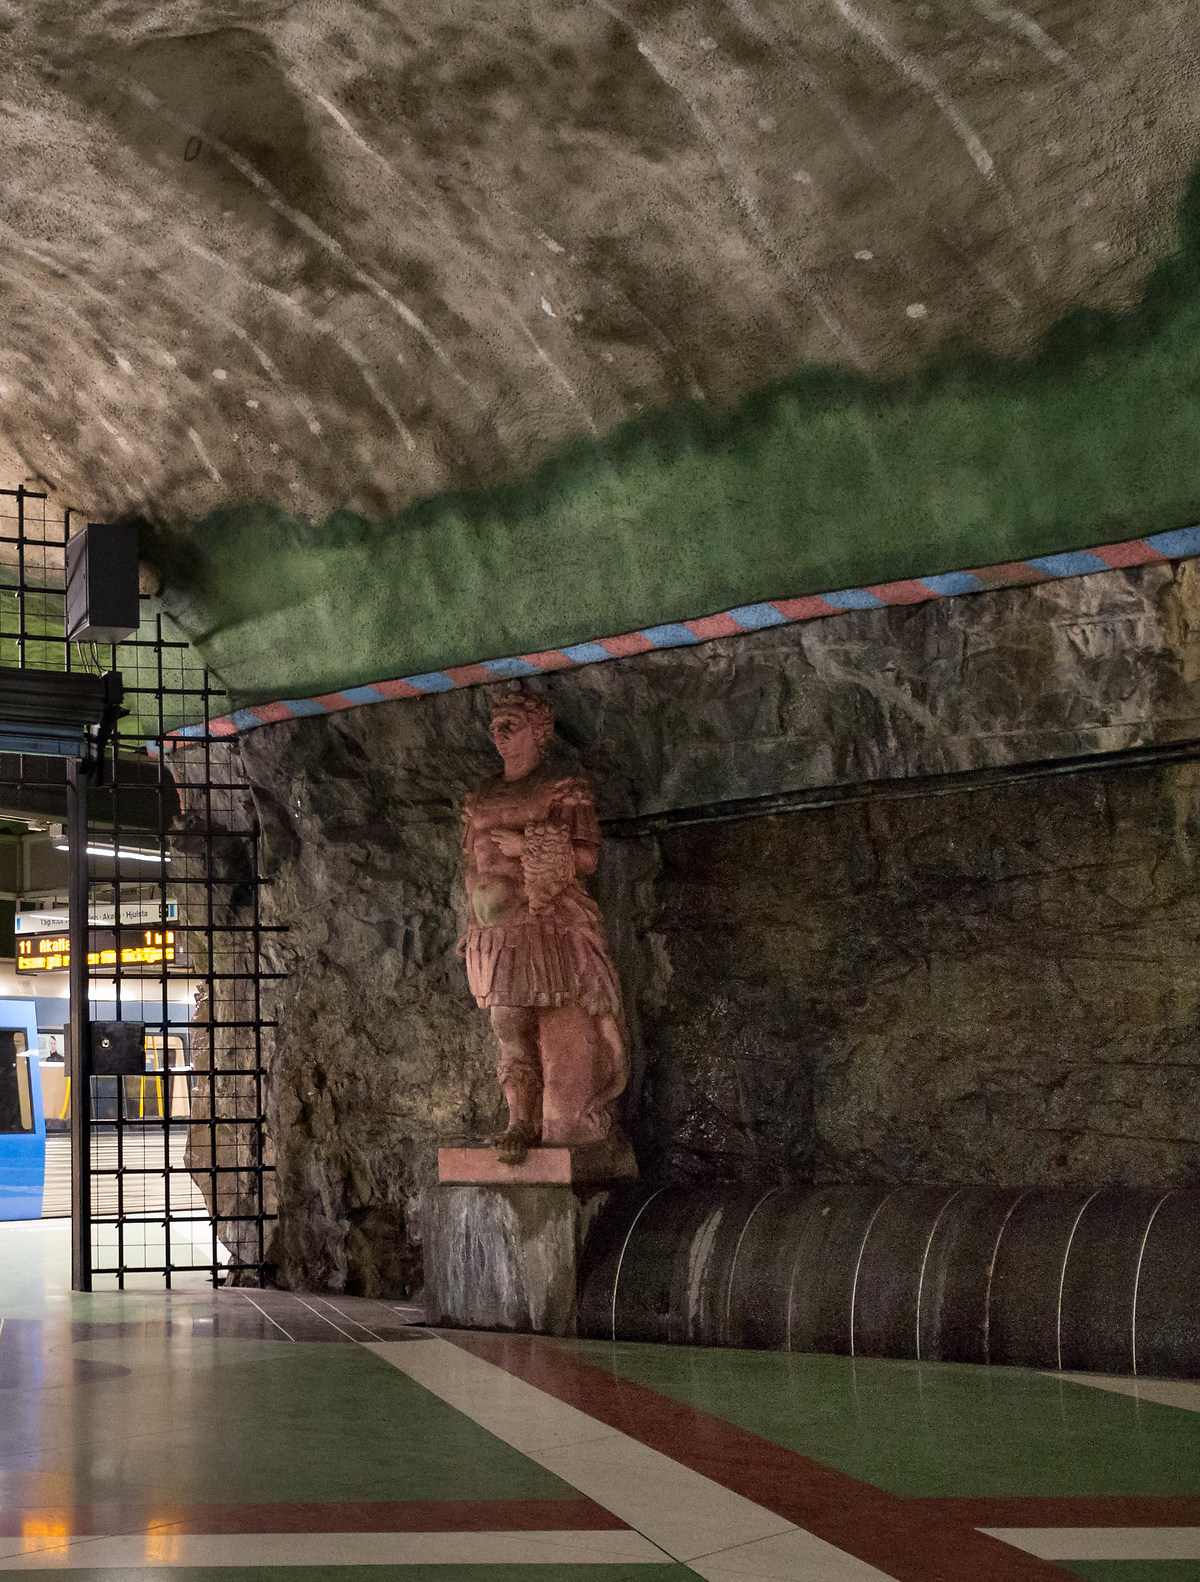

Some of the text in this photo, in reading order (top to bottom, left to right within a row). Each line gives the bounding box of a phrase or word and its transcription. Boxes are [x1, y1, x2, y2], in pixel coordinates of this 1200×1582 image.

[126, 911, 148, 919] Hjulsta
[144, 930, 152, 945] 1
[19, 940, 31, 954] 11
